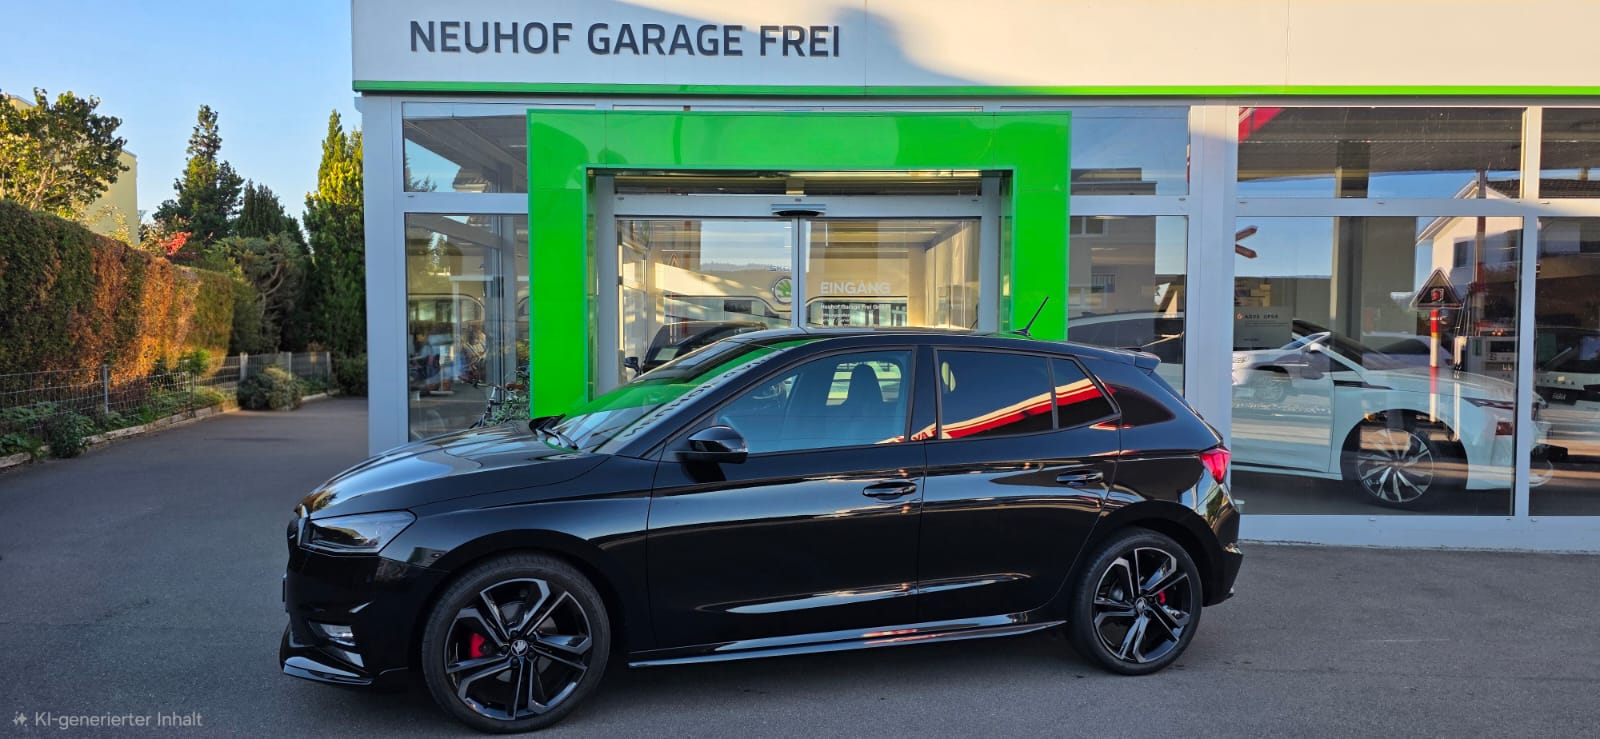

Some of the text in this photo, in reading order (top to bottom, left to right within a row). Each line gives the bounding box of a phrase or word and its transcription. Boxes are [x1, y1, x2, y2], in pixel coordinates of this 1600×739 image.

[409, 20, 841, 58] NEUHOF GARAGE FREI
[820, 281, 891, 295] EINGANG
